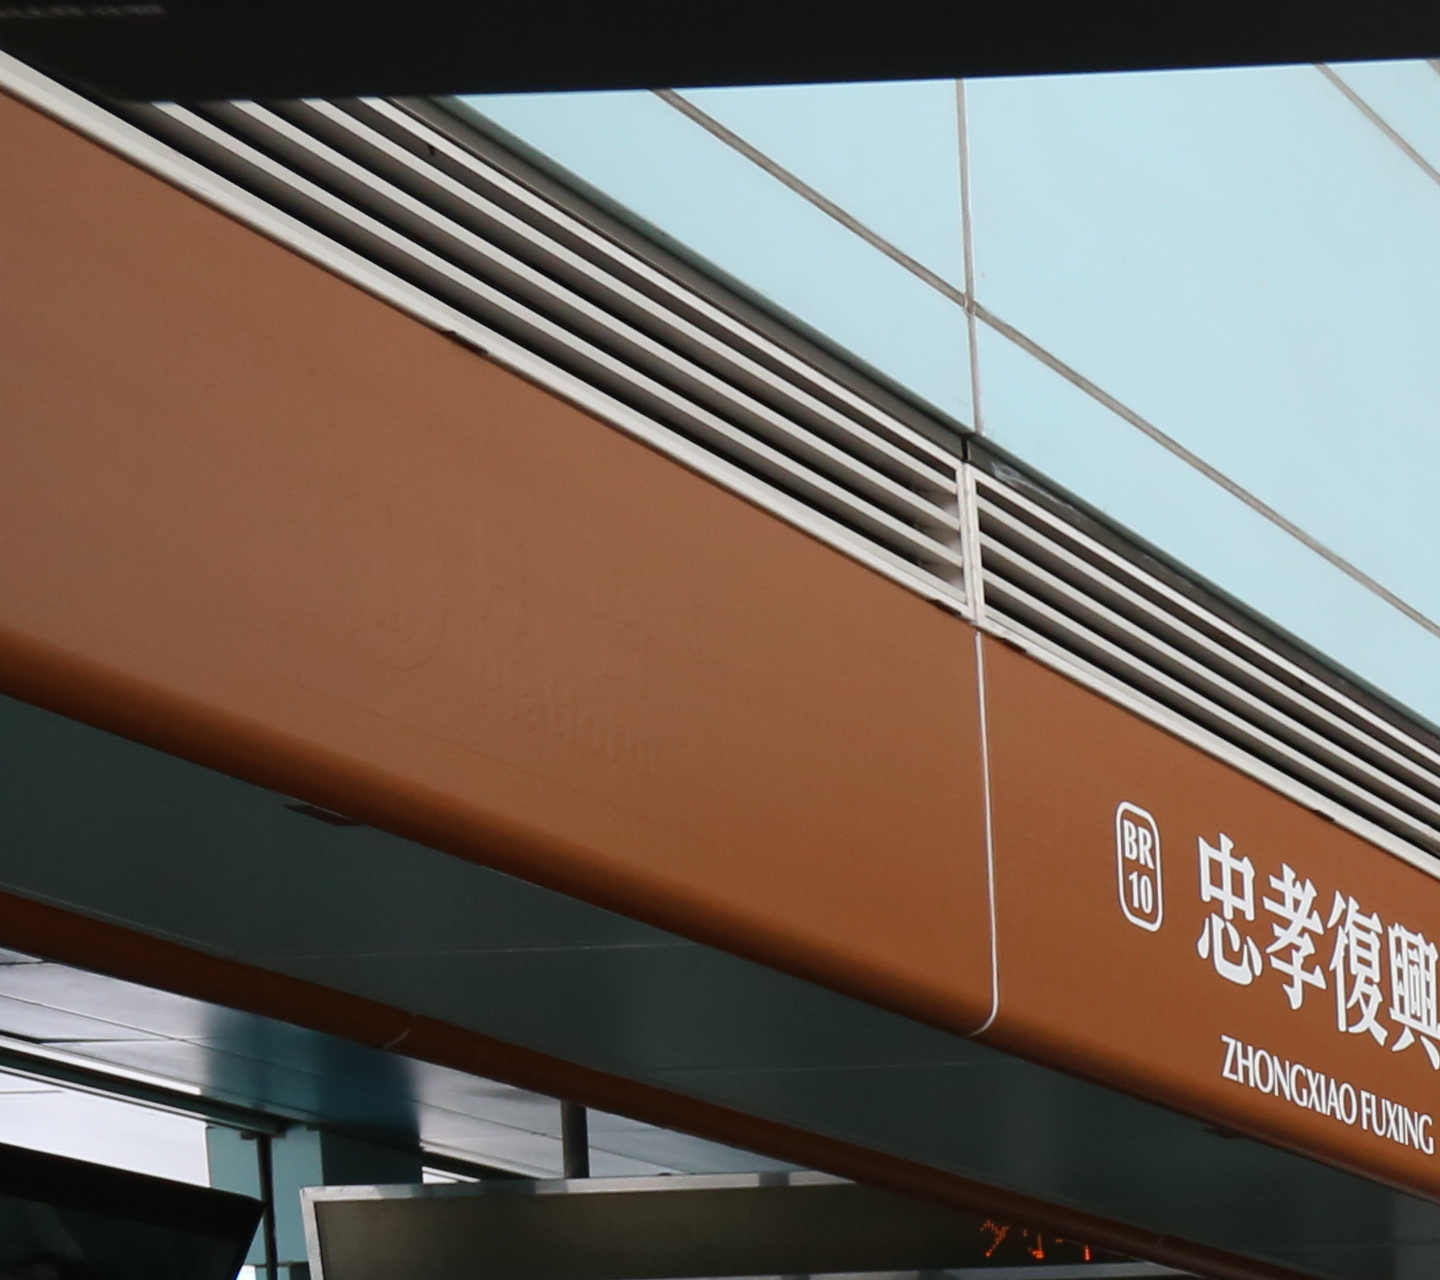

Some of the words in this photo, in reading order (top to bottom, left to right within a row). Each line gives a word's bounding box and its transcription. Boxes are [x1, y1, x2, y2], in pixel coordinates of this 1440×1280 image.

[1124, 819, 1155, 870] BR
[1128, 870, 1154, 915] 10
[1221, 1034, 1358, 1126] ZHONGXIAO
[1360, 1090, 1435, 1155] FUXING
